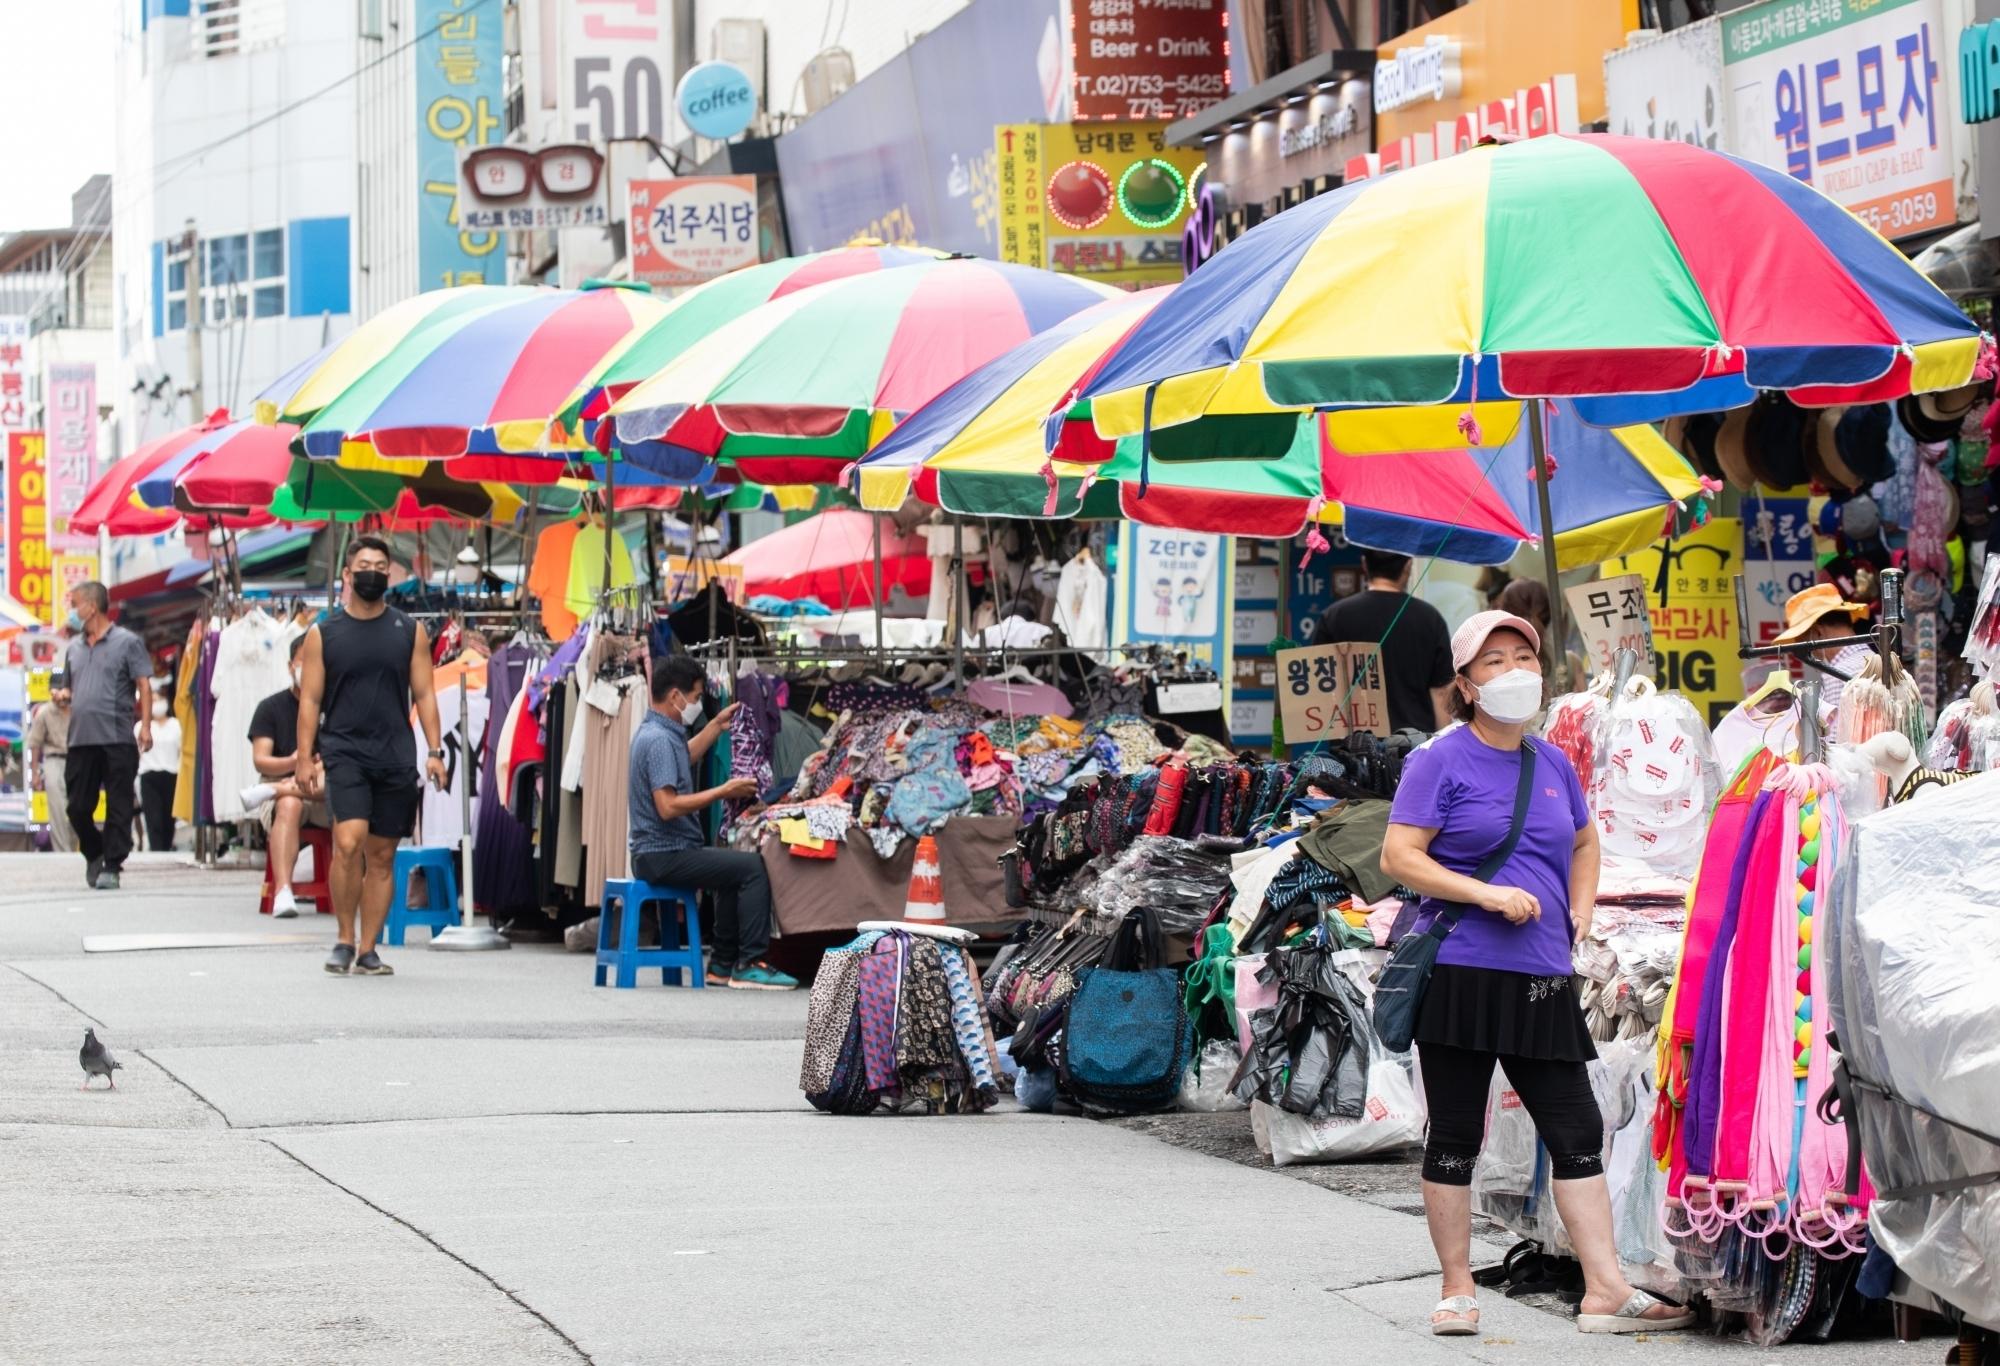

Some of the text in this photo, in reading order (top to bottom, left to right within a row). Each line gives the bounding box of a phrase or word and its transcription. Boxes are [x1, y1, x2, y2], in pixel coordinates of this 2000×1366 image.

[437, 0, 481, 86] 리들
[1089, 19, 1134, 35] 대추차
[1090, 38, 1211, 58] Beer Drink
[574, 56, 663, 142] 50
[688, 86, 750, 117] coffee
[1077, 74, 1223, 97] T.02)753-5425
[1775, 22, 1939, 186] 월드모자
[1075, 131, 1136, 154] 남대문
[1024, 168, 1040, 215] 20m
[1823, 149, 1924, 194] WORLD CAP & HAT
[653, 201, 754, 244] 전주식당
[1853, 192, 1937, 232] 55-3059
[1, 344, 23, 426] 부동산
[1149, 538, 1208, 558] zero
[1297, 572, 1324, 596] 11F
[1287, 655, 1338, 697] 왕창
[1351, 652, 1381, 691] 세일
[1652, 650, 1717, 693] BIG
[1304, 702, 1380, 733] SALE
